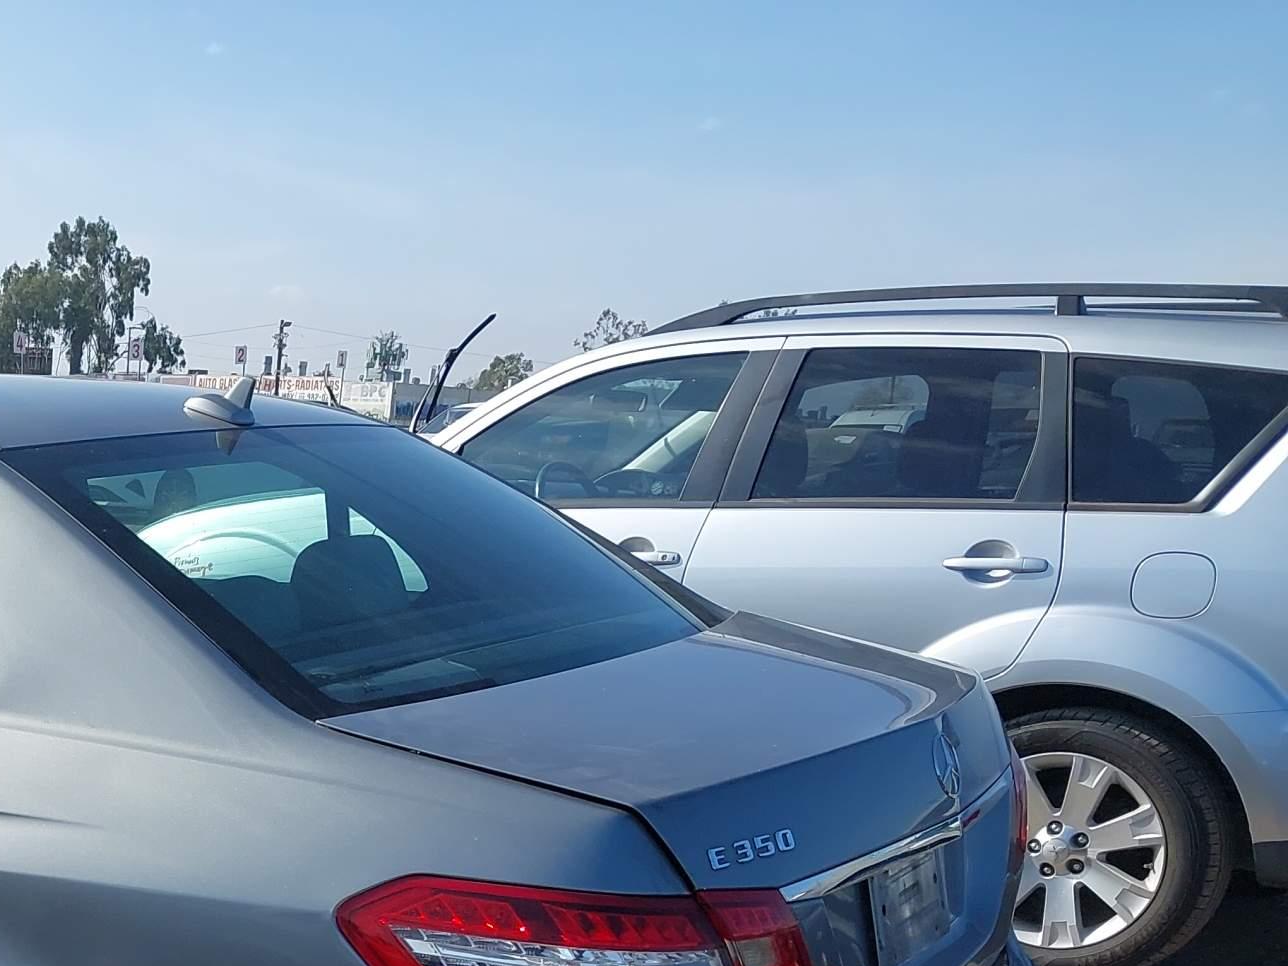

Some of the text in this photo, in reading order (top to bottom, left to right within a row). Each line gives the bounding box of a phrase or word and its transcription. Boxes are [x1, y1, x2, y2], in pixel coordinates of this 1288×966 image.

[16, 334, 24, 352] 4
[132, 343, 140, 359] 3
[237, 348, 245, 363] 2
[198, 377, 217, 388] AUTO
[219, 378, 237, 389] GLAS
[707, 828, 796, 871] E 350
